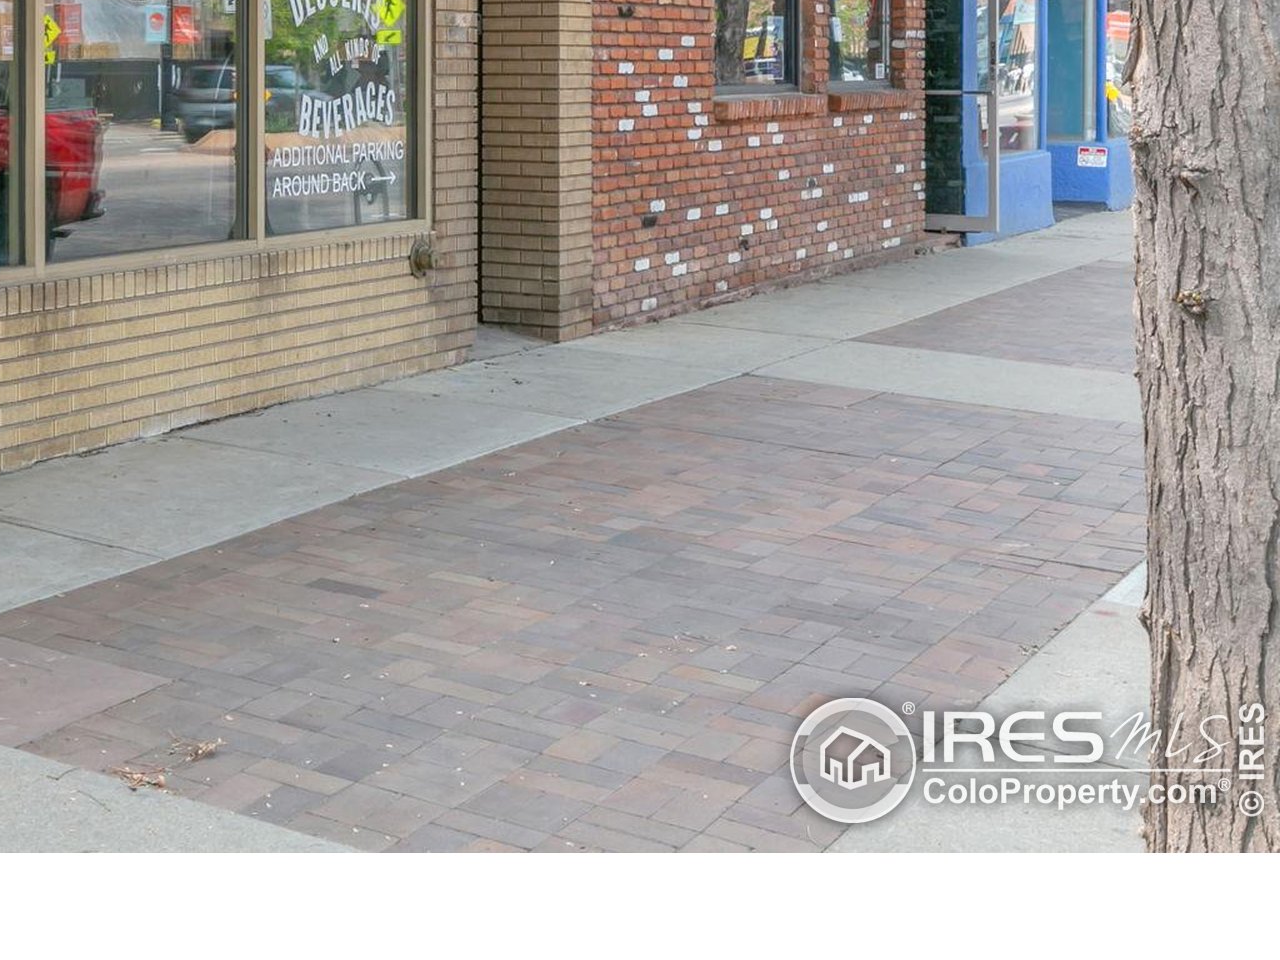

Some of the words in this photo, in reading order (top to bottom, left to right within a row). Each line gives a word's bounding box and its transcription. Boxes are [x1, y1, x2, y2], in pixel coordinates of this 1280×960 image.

[313, 33, 329, 64] AND
[329, 51, 343, 76] ALL
[344, 37, 370, 62] KINDS
[299, 81, 396, 140] BEVERAGES
[273, 144, 350, 167] ADDITIONAL
[353, 141, 404, 162] PARKING
[273, 173, 330, 198] AROUND
[332, 171, 366, 193] BACK
